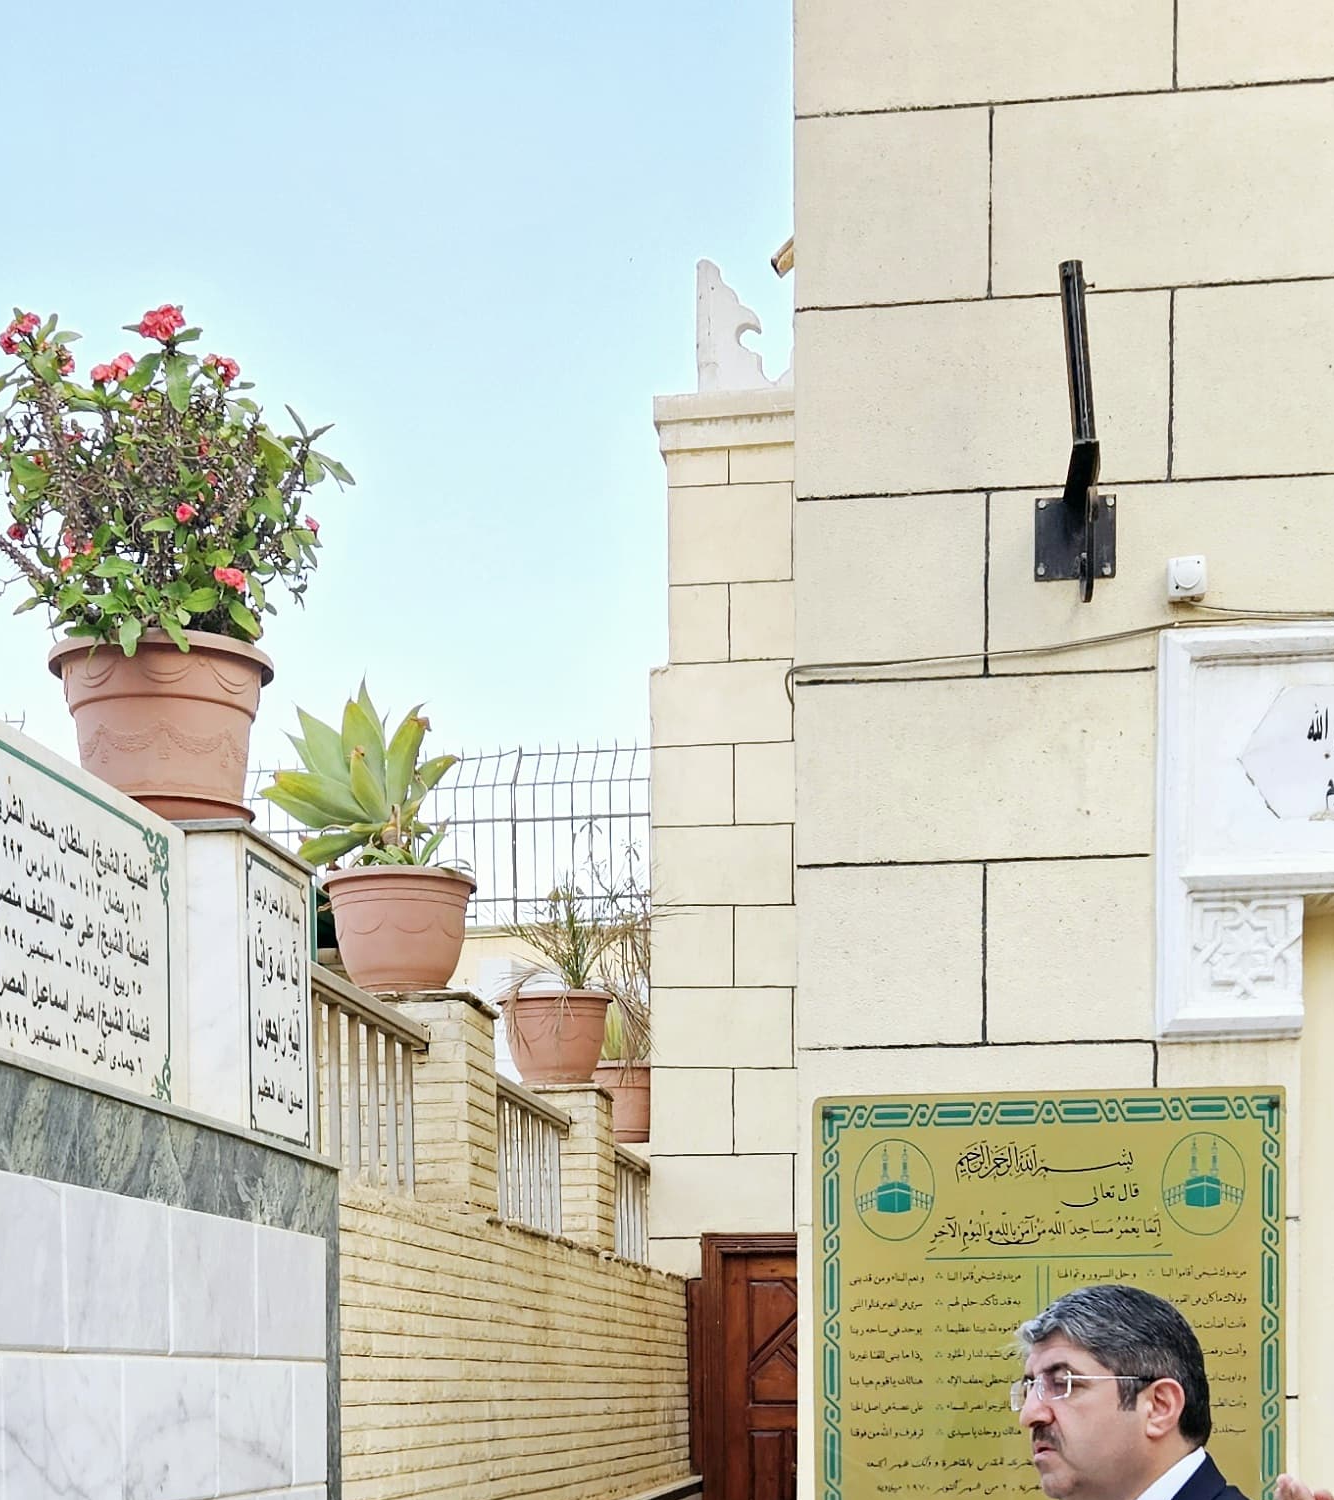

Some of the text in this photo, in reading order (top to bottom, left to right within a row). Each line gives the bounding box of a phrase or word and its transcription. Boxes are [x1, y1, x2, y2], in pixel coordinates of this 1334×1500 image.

[1307, 703, 1328, 742] الله
[30, 811, 55, 840] محمد
[58, 824, 89, 859] سلطان
[26, 853, 51, 882] مارس
[123, 853, 149, 890] فضيلة
[25, 889, 55, 924] اللطيف
[103, 889, 129, 924] رمضان
[59, 909, 74, 936] عبد
[27, 941, 54, 963] سبتمبر
[126, 931, 149, 967] فضيلة
[113, 976, 130, 997] ربيع
[73, 995, 95, 1023] صابر
[31, 1025, 61, 1050] سبتمبر
[126, 1008, 150, 1044] فضيلة
[1118, 1182, 1140, 1202] قال
